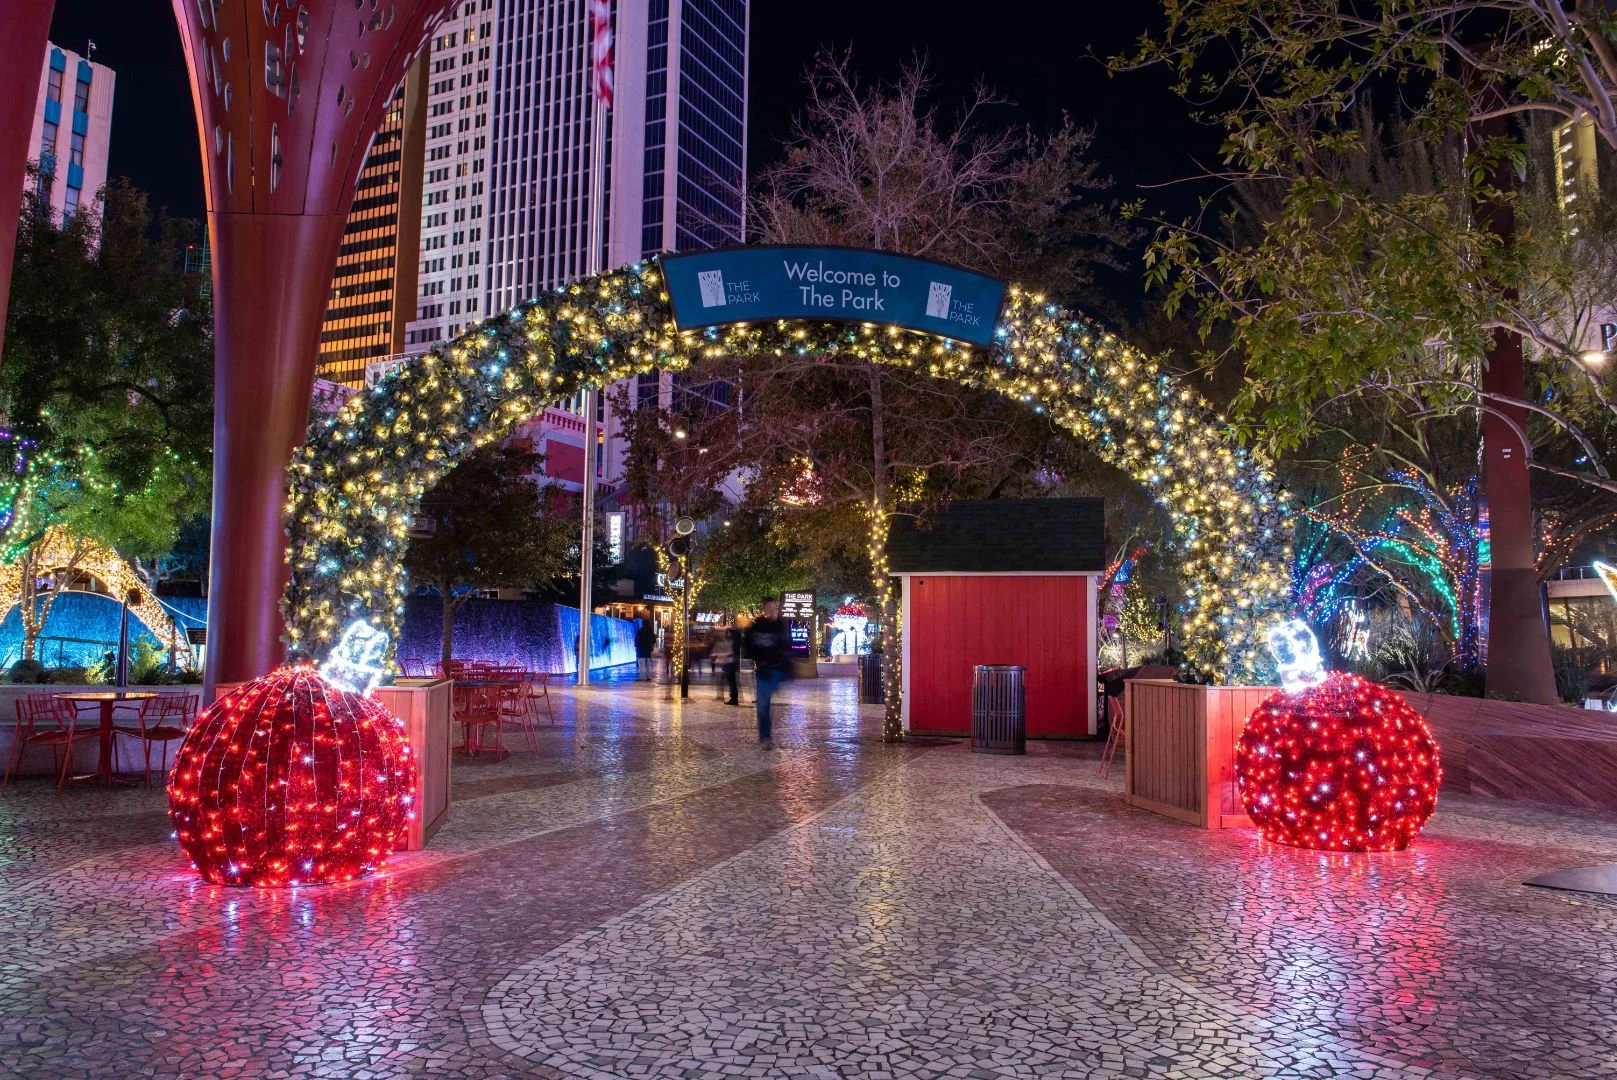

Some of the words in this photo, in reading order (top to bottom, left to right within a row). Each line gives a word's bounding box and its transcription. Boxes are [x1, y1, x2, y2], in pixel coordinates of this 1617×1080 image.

[783, 260, 876, 286] Welcome
[882, 270, 900, 288] to
[727, 280, 750, 292] THE
[727, 291, 760, 305] PARK
[799, 284, 834, 307] The
[842, 288, 885, 311] Park
[952, 299, 974, 313] THE
[949, 311, 980, 327] PARK
